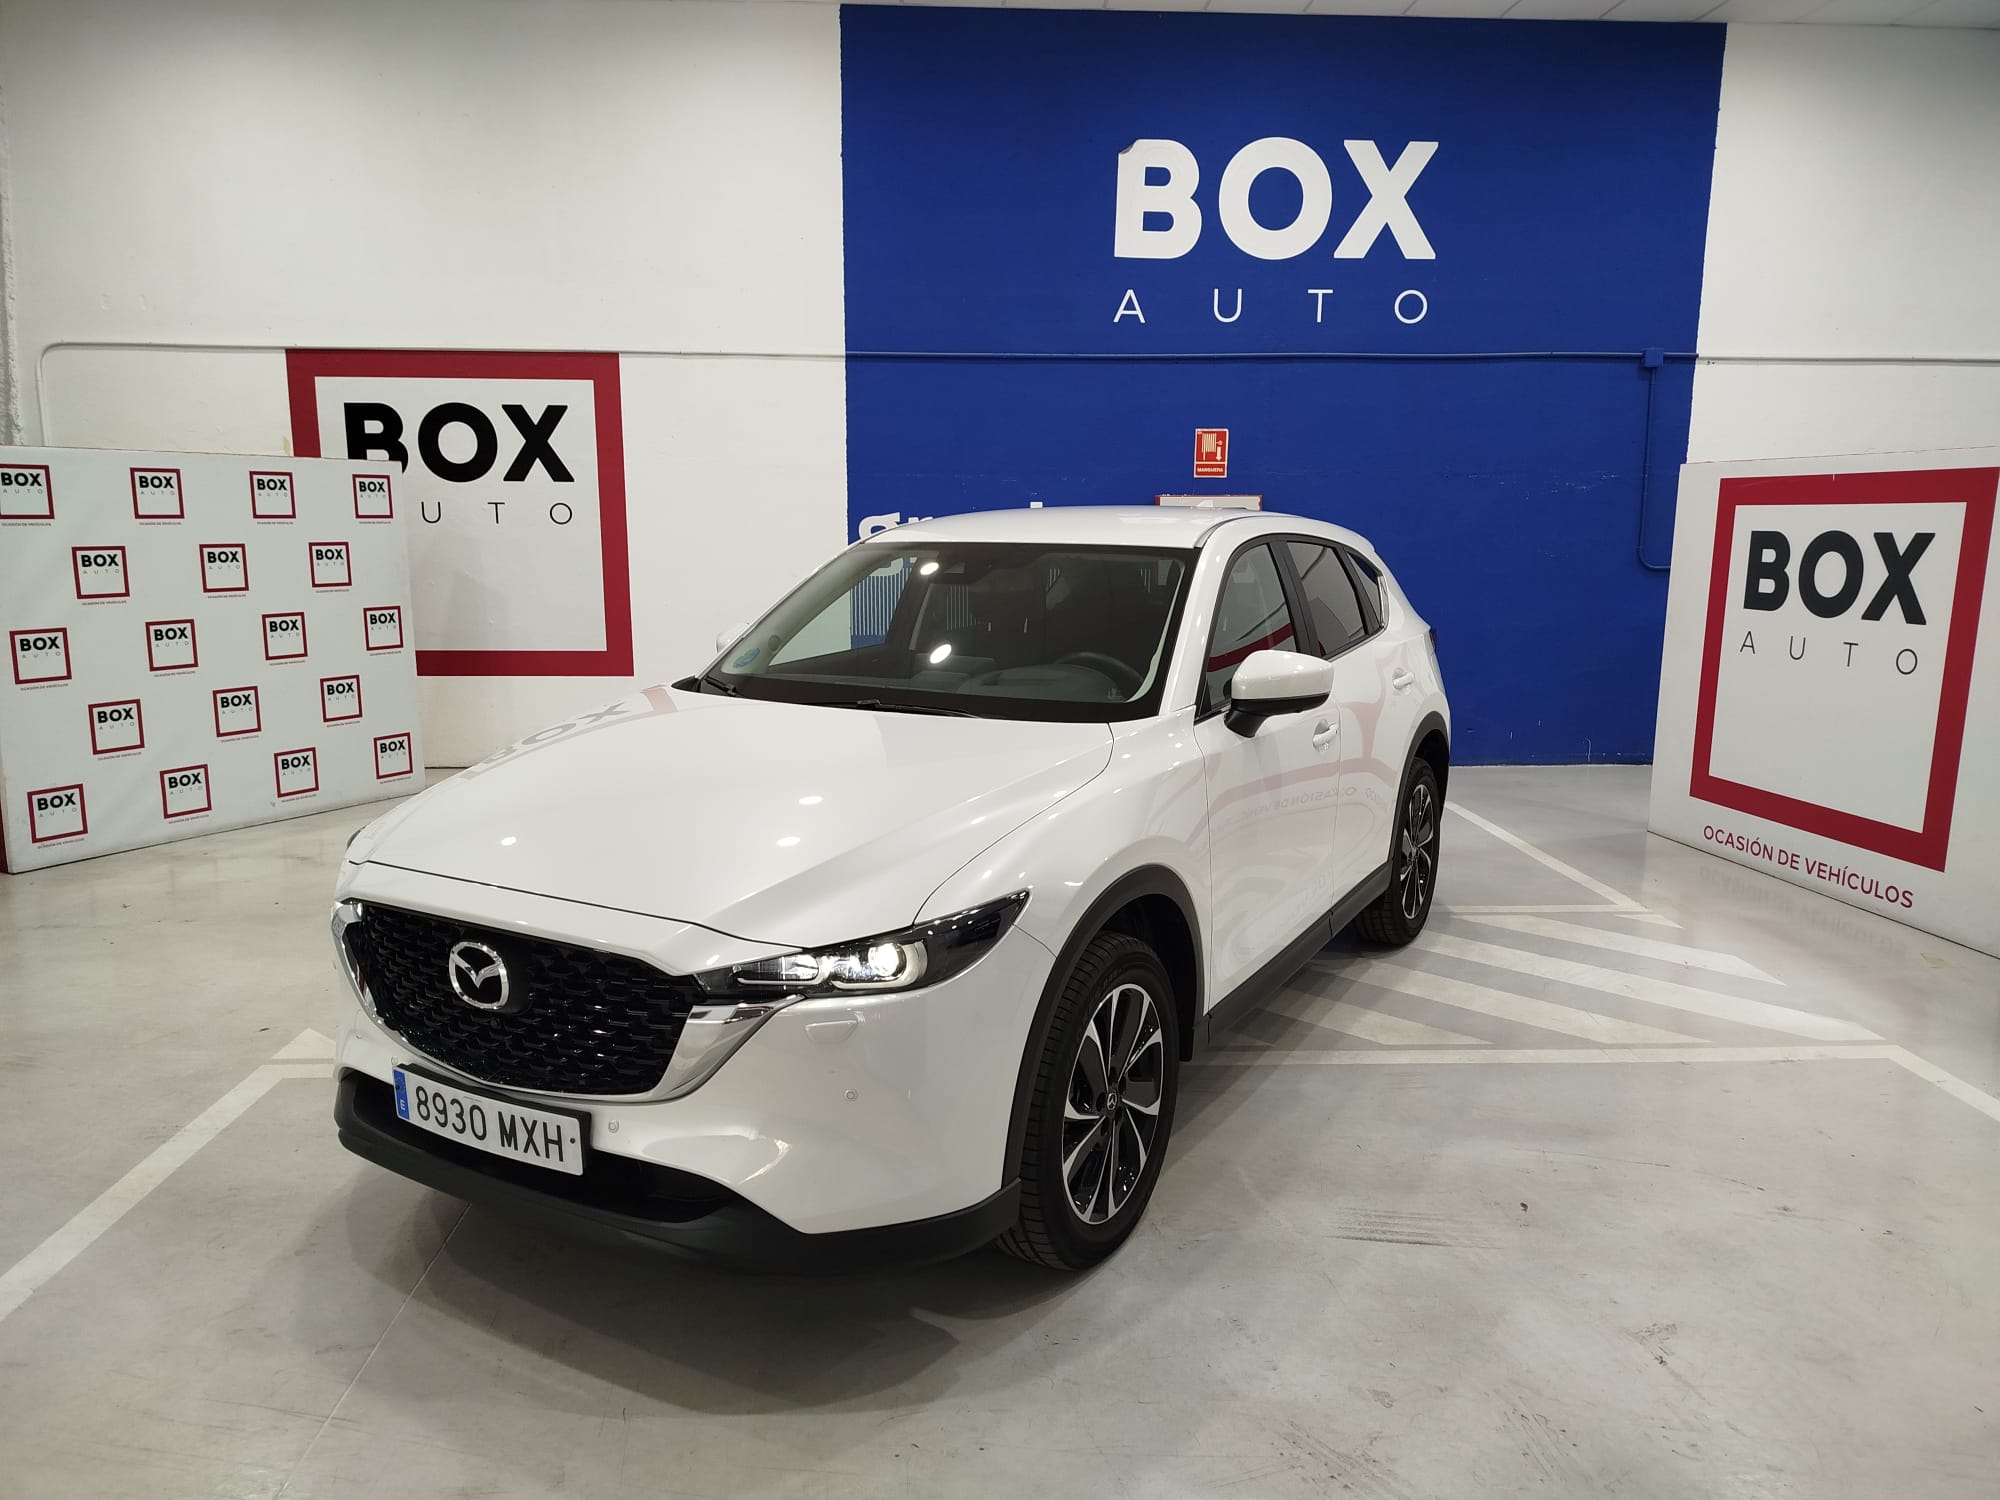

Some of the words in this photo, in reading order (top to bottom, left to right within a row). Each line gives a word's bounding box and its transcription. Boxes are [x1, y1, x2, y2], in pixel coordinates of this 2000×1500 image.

[1114, 136, 1439, 260] BOX
[1113, 288, 1428, 324] AUTO
[344, 402, 575, 483] BOX
[1, 472, 42, 486] BOX
[138, 476, 174, 488] BOX
[257, 479, 287, 491] BOX
[359, 482, 385, 492] BOX
[421, 501, 573, 525] UTO
[81, 554, 119, 568] BOX
[207, 551, 239, 564] BOX
[316, 549, 343, 560] BOX
[1744, 530, 1935, 625] BOX
[370, 613, 395, 624] BOX
[270, 620, 299, 632] BOX
[154, 627, 188, 641] BOX
[19, 636, 60, 652] BOX
[1740, 631, 1918, 674] AUTO
[327, 682, 354, 695] BOX
[221, 694, 252, 708] BOX
[97, 708, 134, 723] BOX
[380, 740, 405, 753] BOX
[281, 755, 310, 769] BOX
[168, 773, 201, 789] BOX
[37, 793, 76, 811] BOX
[1703, 825, 1773, 861] OCASIÓN
[1778, 850, 1800, 870] DE
[1804, 858, 1914, 908] VEHÍCULOS
[416, 1086, 487, 1140] 8930
[498, 1111, 564, 1162] MXH
